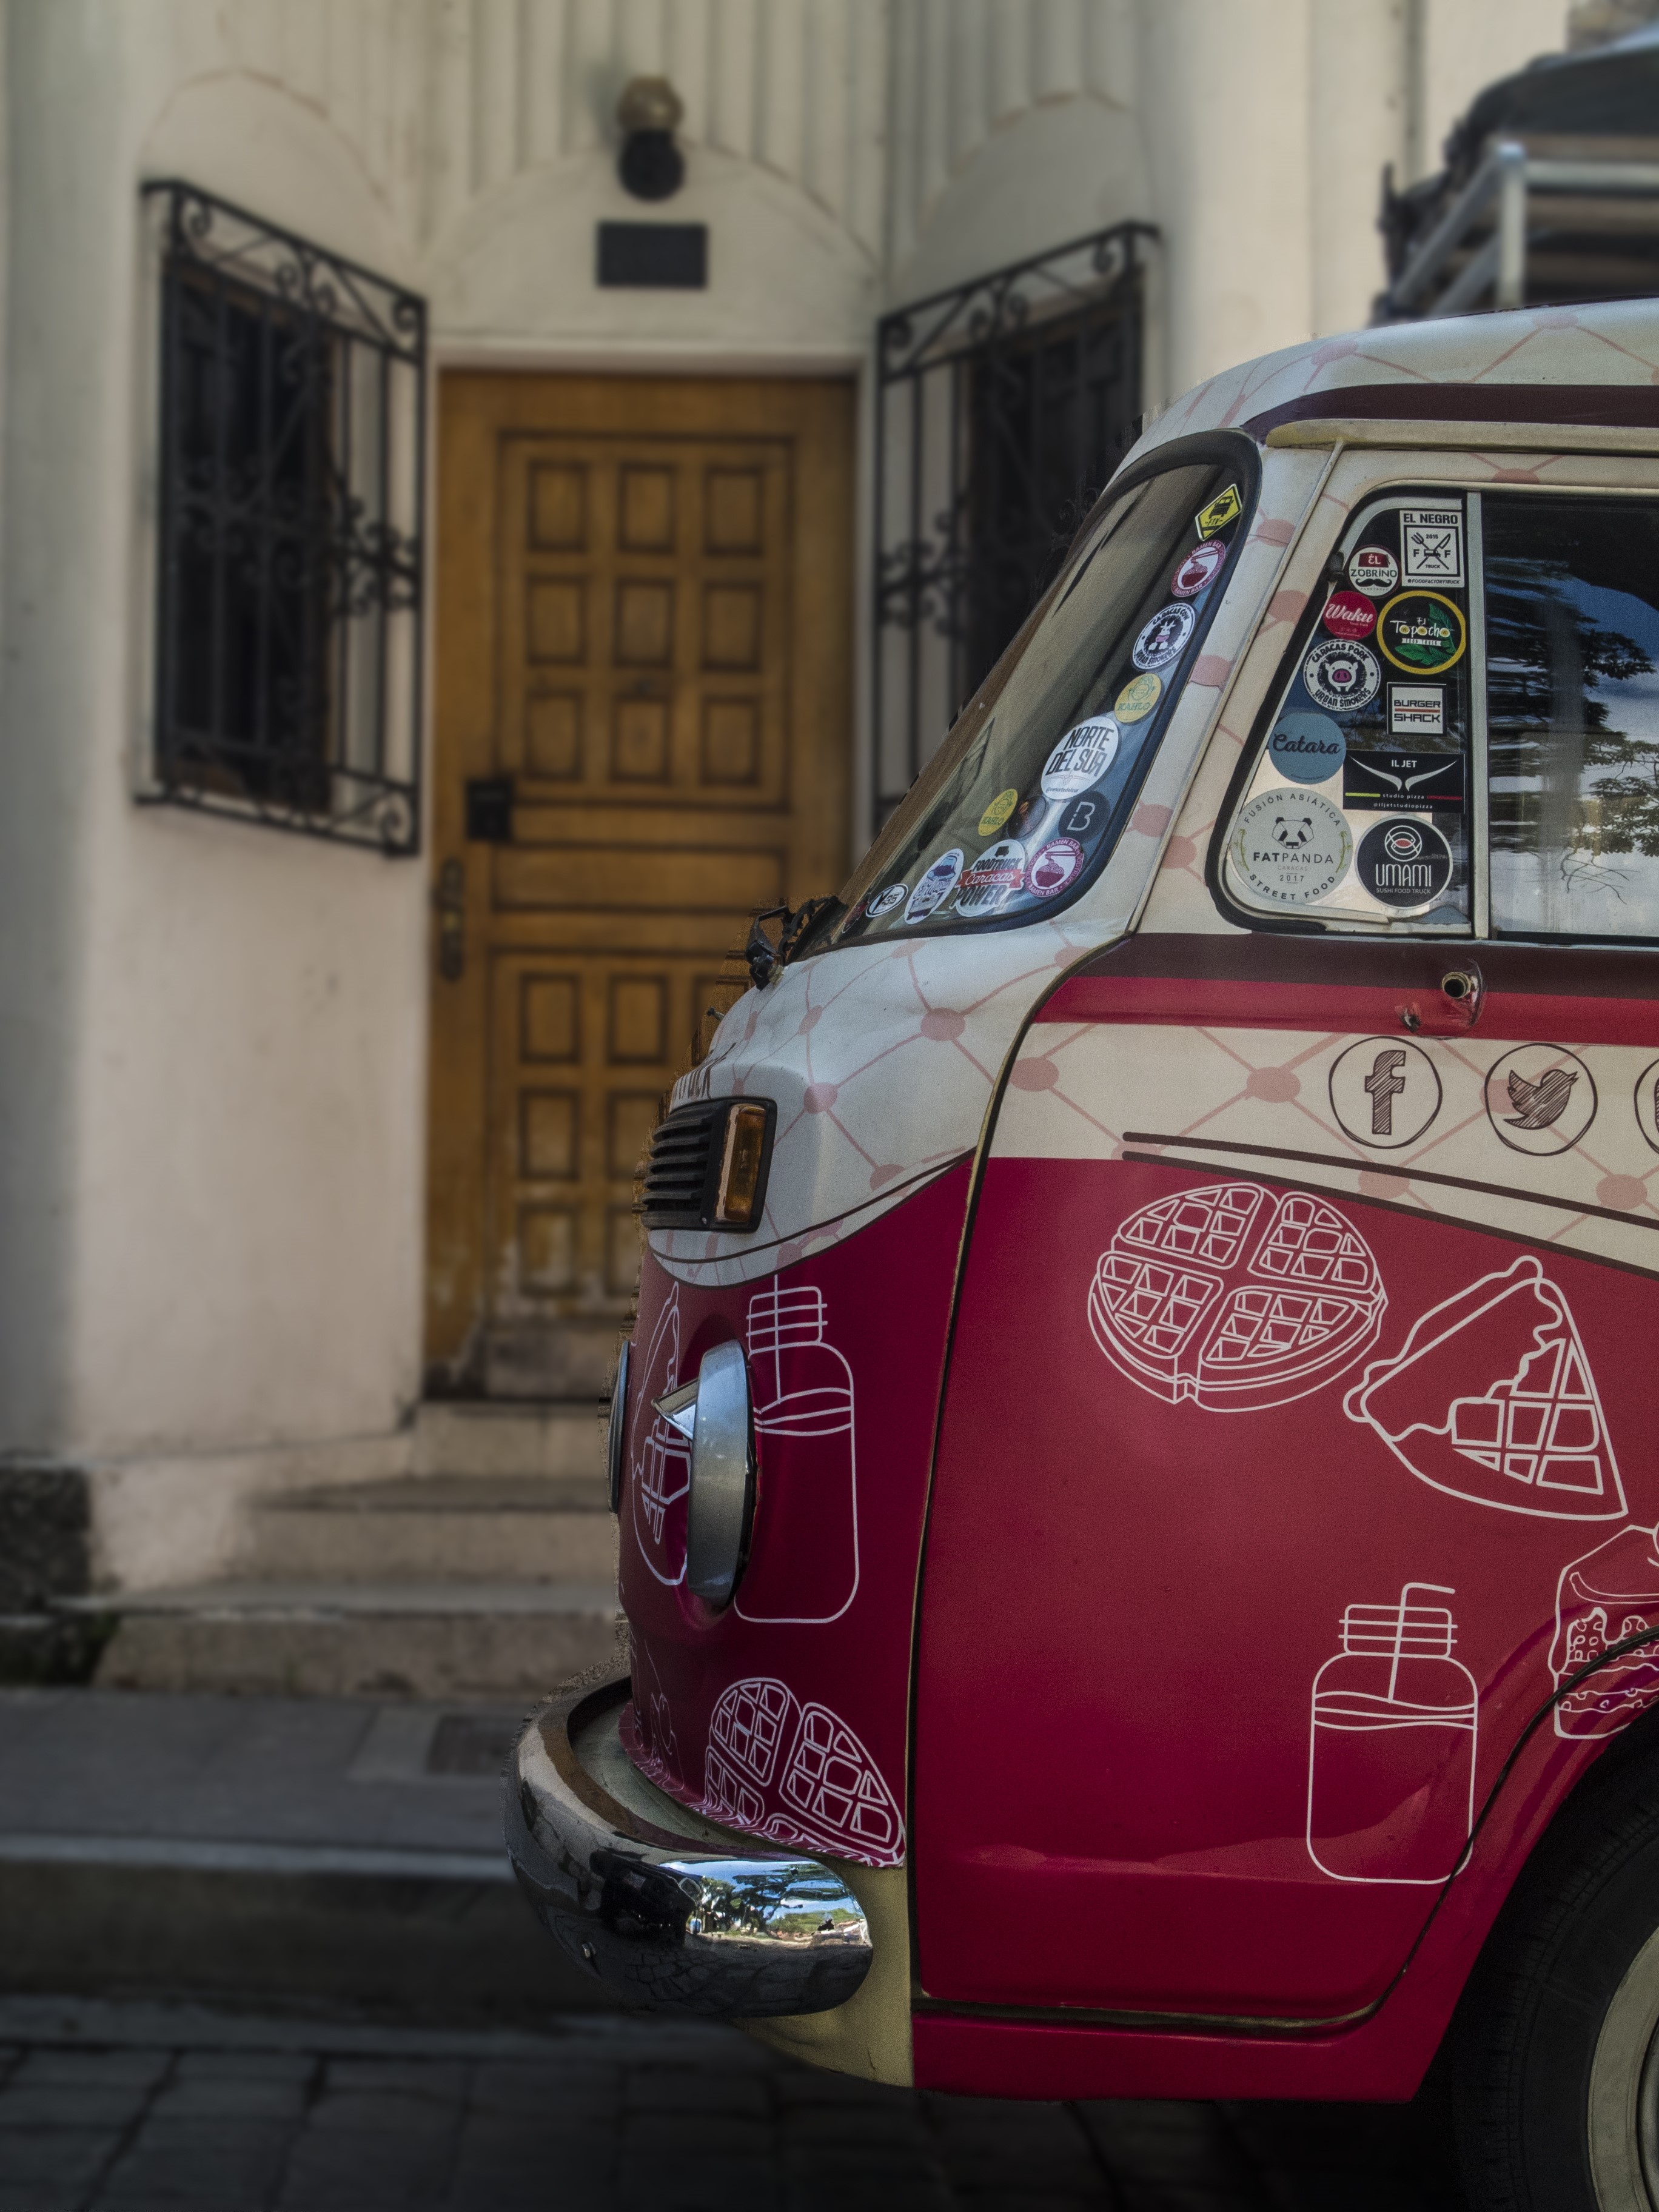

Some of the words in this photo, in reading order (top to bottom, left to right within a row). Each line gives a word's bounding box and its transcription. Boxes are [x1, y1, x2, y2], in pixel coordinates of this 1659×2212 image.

[1403, 514, 1416, 523] EL
[1419, 514, 1458, 525] NEGRO
[1413, 549, 1419, 557] F
[1350, 569, 1397, 578] ZOBRINO
[1153, 607, 1181, 625] CARACAS
[1180, 608, 1190, 621] COW
[1326, 604, 1374, 623] Waku
[1390, 620, 1450, 638] Topocho
[1416, 617, 1426, 626] El
[1312, 643, 1346, 663] CARACAS
[1347, 645, 1370, 662] PORK
[1315, 689, 1338, 707] URBAN
[1339, 688, 1371, 708] SMOKERS
[1394, 700, 1441, 708] BURGER
[1118, 702, 1151, 711] KAHLO
[1394, 713, 1441, 723] SHACK
[1063, 726, 1114, 751] NORTE
[1273, 734, 1341, 754] Catara
[1045, 749, 1076, 776] DEL
[1401, 760, 1418, 768] JET
[1244, 794, 1282, 824] FUSIÓN
[1290, 793, 1341, 826] ASIÁTICA
[1047, 839, 1069, 849] RAMEN
[1068, 840, 1079, 850] BAR
[973, 858, 1022, 871] FOODTRUCK
[1253, 852, 1333, 864] FATPANDA
[965, 873, 1016, 886] Caracas
[1376, 863, 1432, 887] UMAMI
[1028, 884, 1045, 895] RAMEN
[1250, 874, 1296, 900] STREET
[1305, 876, 1335, 899] FOOD
[950, 885, 1008, 907] POWER
[1365, 1050, 1406, 1135] f
